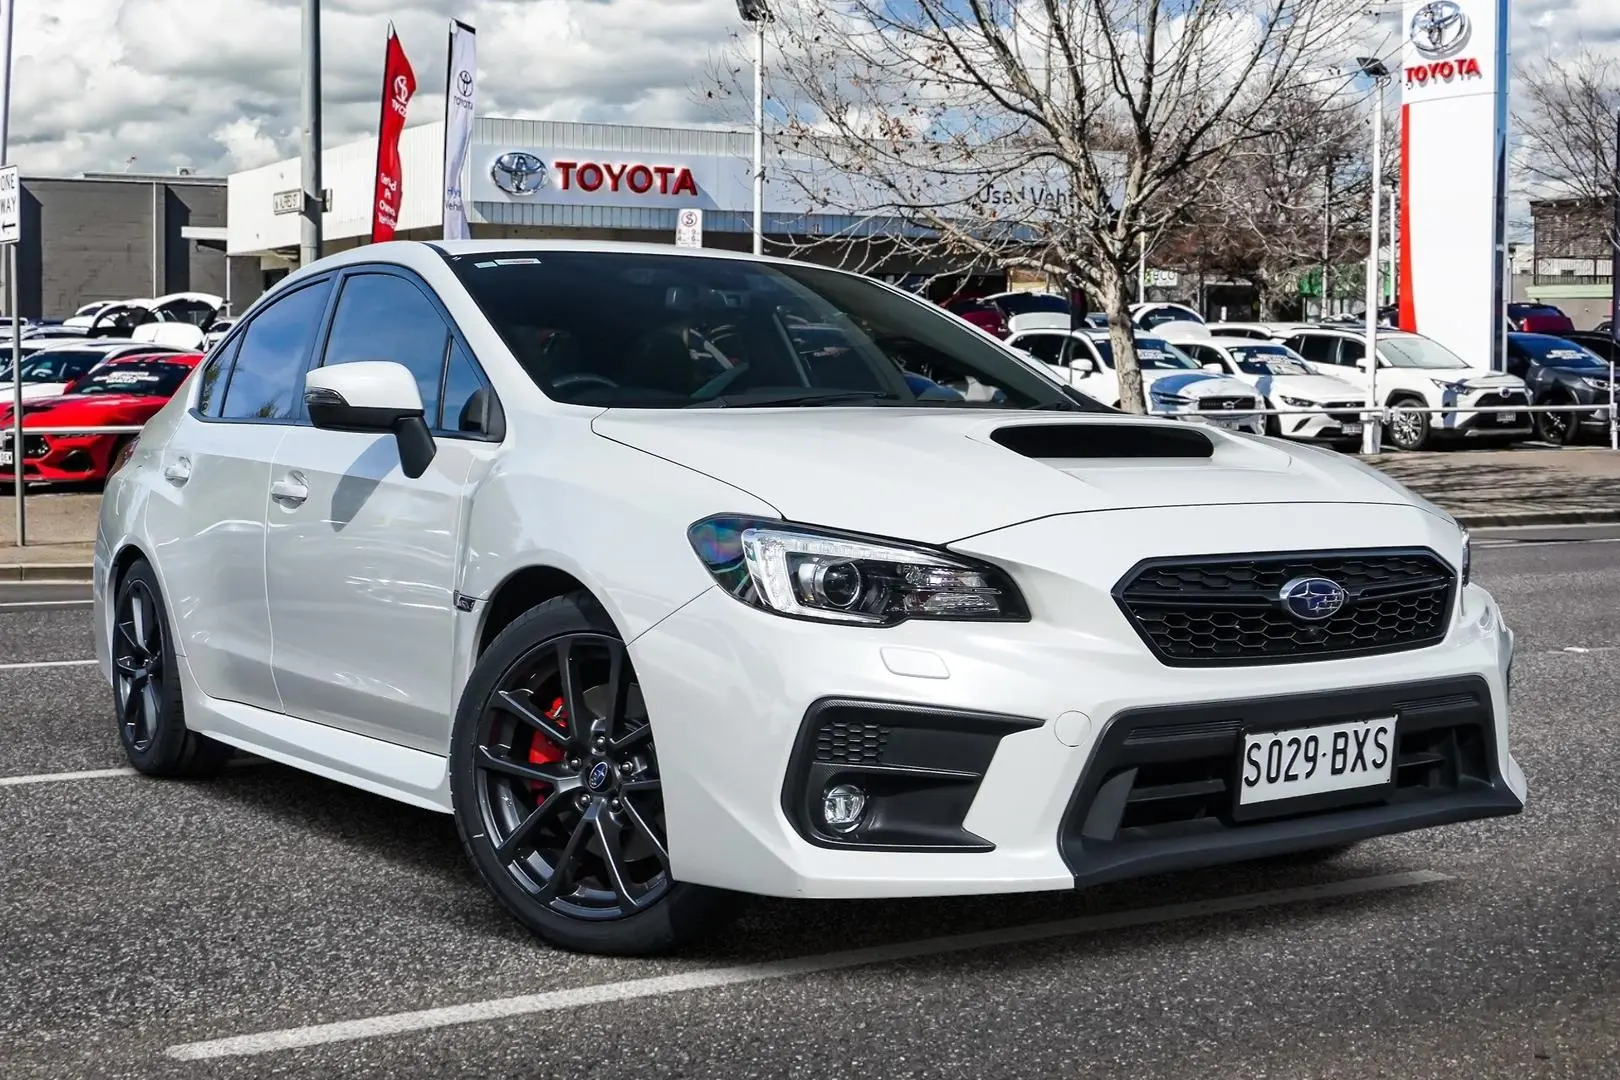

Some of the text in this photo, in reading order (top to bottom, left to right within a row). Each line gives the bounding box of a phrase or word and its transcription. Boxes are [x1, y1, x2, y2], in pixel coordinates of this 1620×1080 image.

[1404, 58, 1482, 83] TOYOTA
[554, 161, 698, 196] TOYOTA
[0, 196, 16, 213] WAY
[977, 185, 1025, 205] Used
